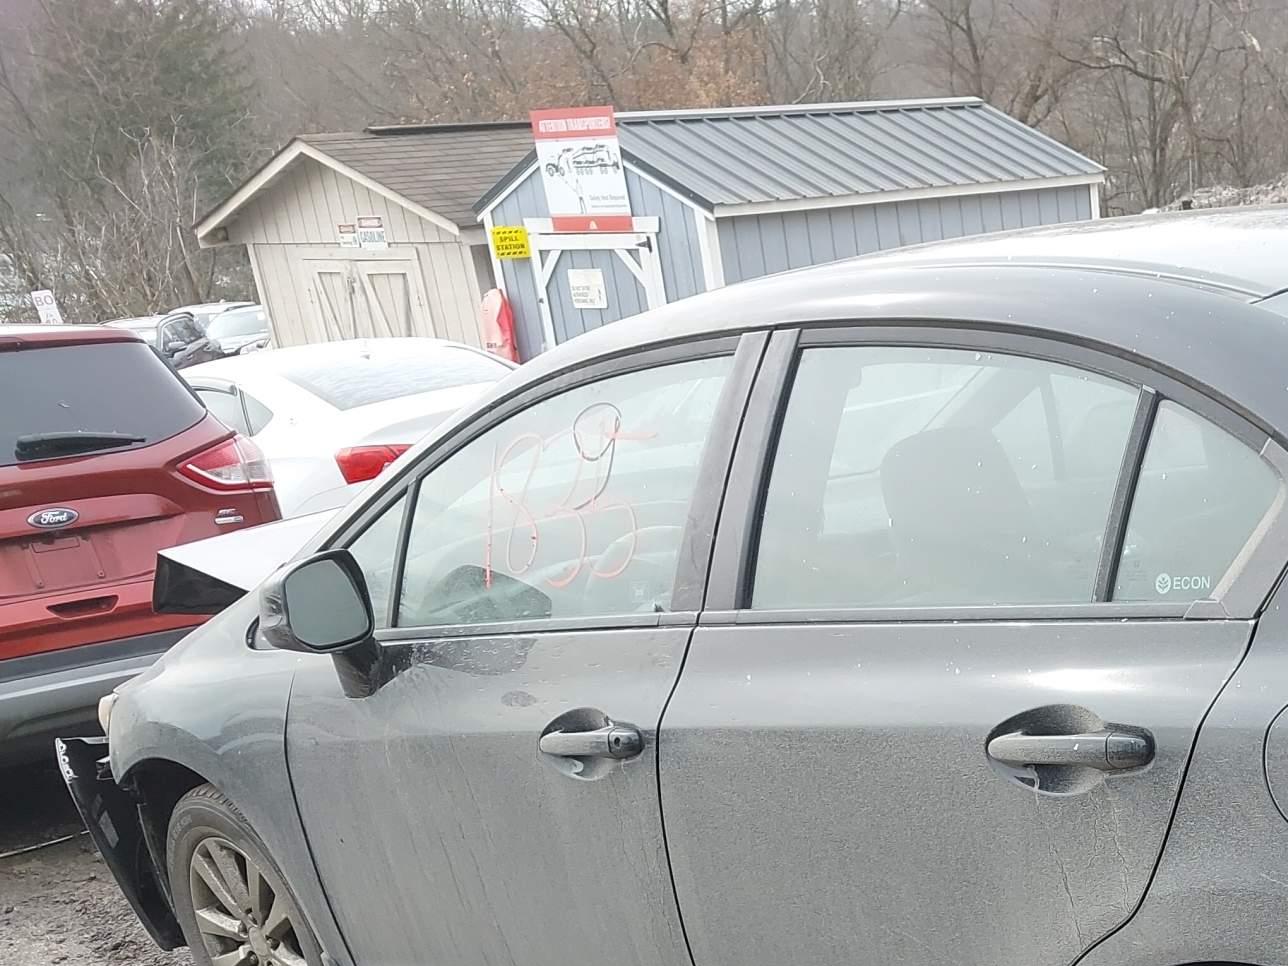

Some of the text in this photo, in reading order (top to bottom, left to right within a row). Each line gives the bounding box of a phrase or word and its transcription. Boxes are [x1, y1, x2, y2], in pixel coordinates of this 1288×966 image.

[496, 243, 526, 251] STATION
[40, 511, 68, 524] Ford
[1172, 575, 1211, 590] ECON
